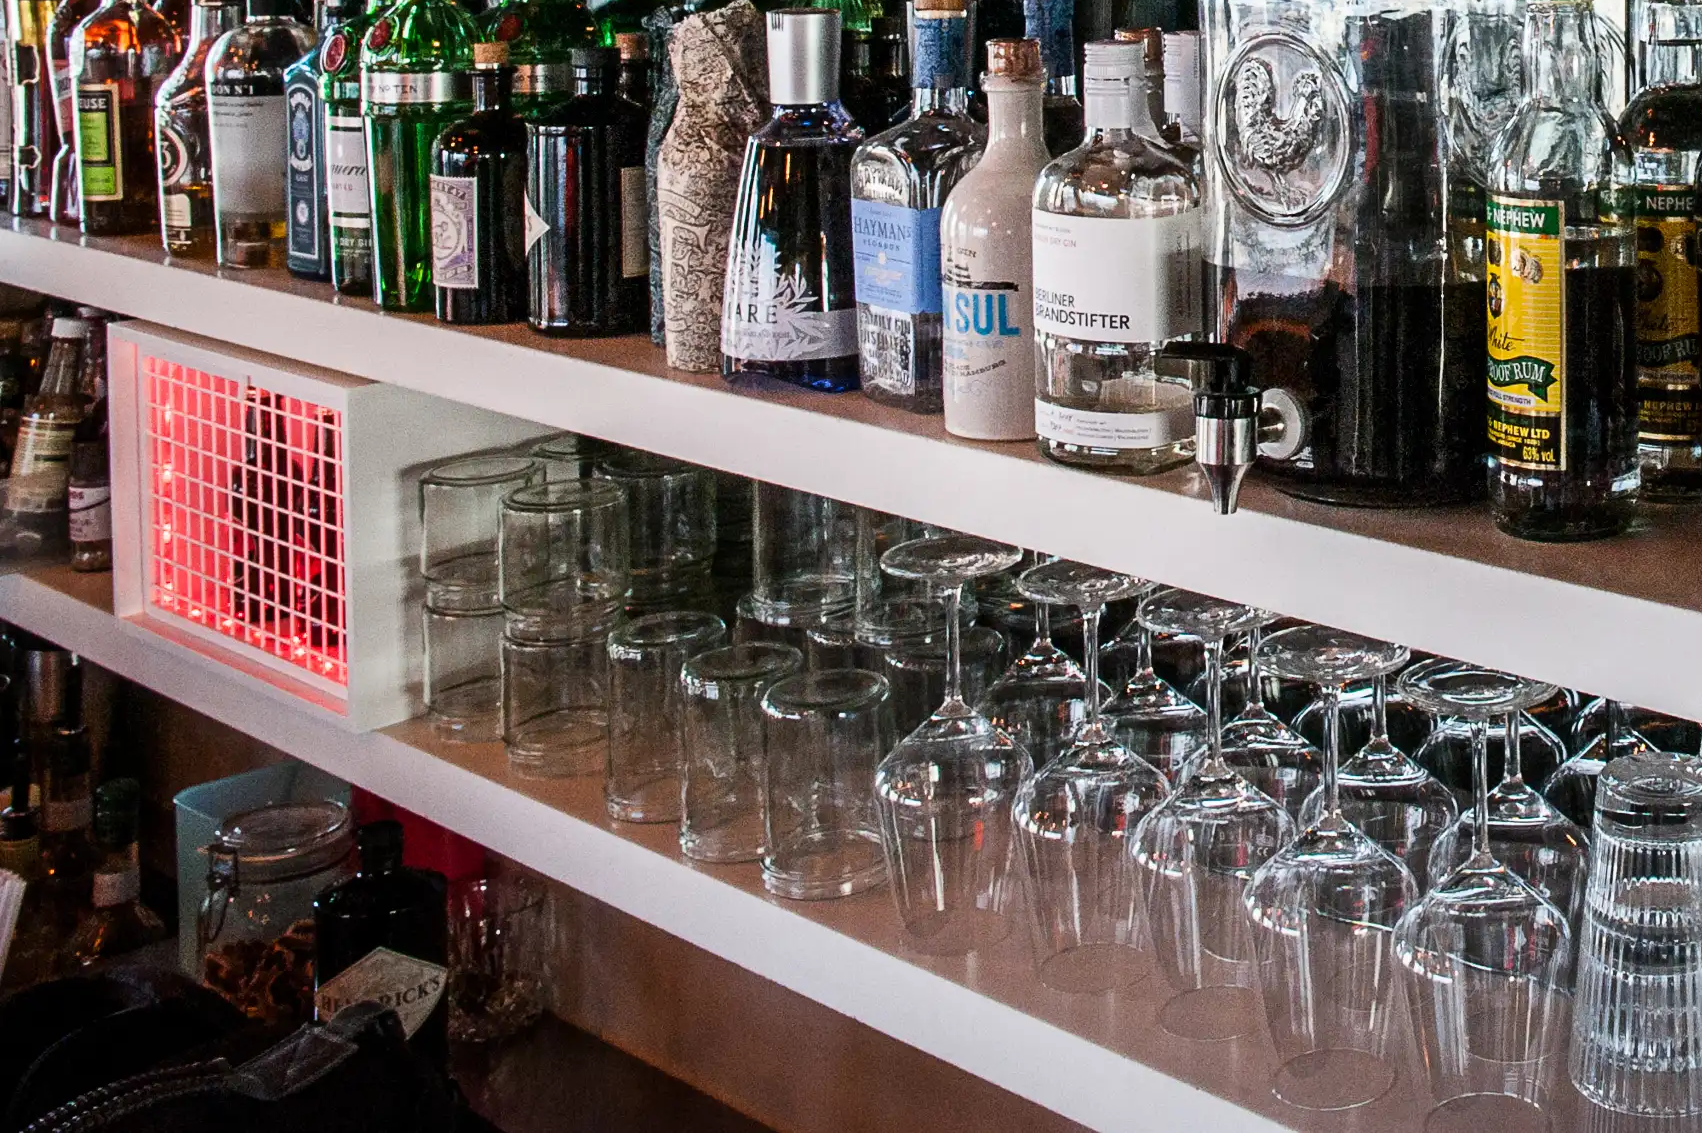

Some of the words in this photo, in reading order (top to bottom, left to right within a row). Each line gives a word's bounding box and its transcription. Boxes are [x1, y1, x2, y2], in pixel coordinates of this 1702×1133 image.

[393, 84, 418, 94] TEN
[1493, 209, 1545, 228] NEPHEW
[1035, 286, 1075, 308] BERLINER
[955, 291, 1021, 337] SUL
[1035, 302, 1130, 330] BRANDSTIFTER
[1513, 361, 1546, 383] RUM
[1493, 419, 1529, 437] NEPHEW
[1531, 428, 1550, 439] LTD
[1522, 446, 1539, 462] 63%
